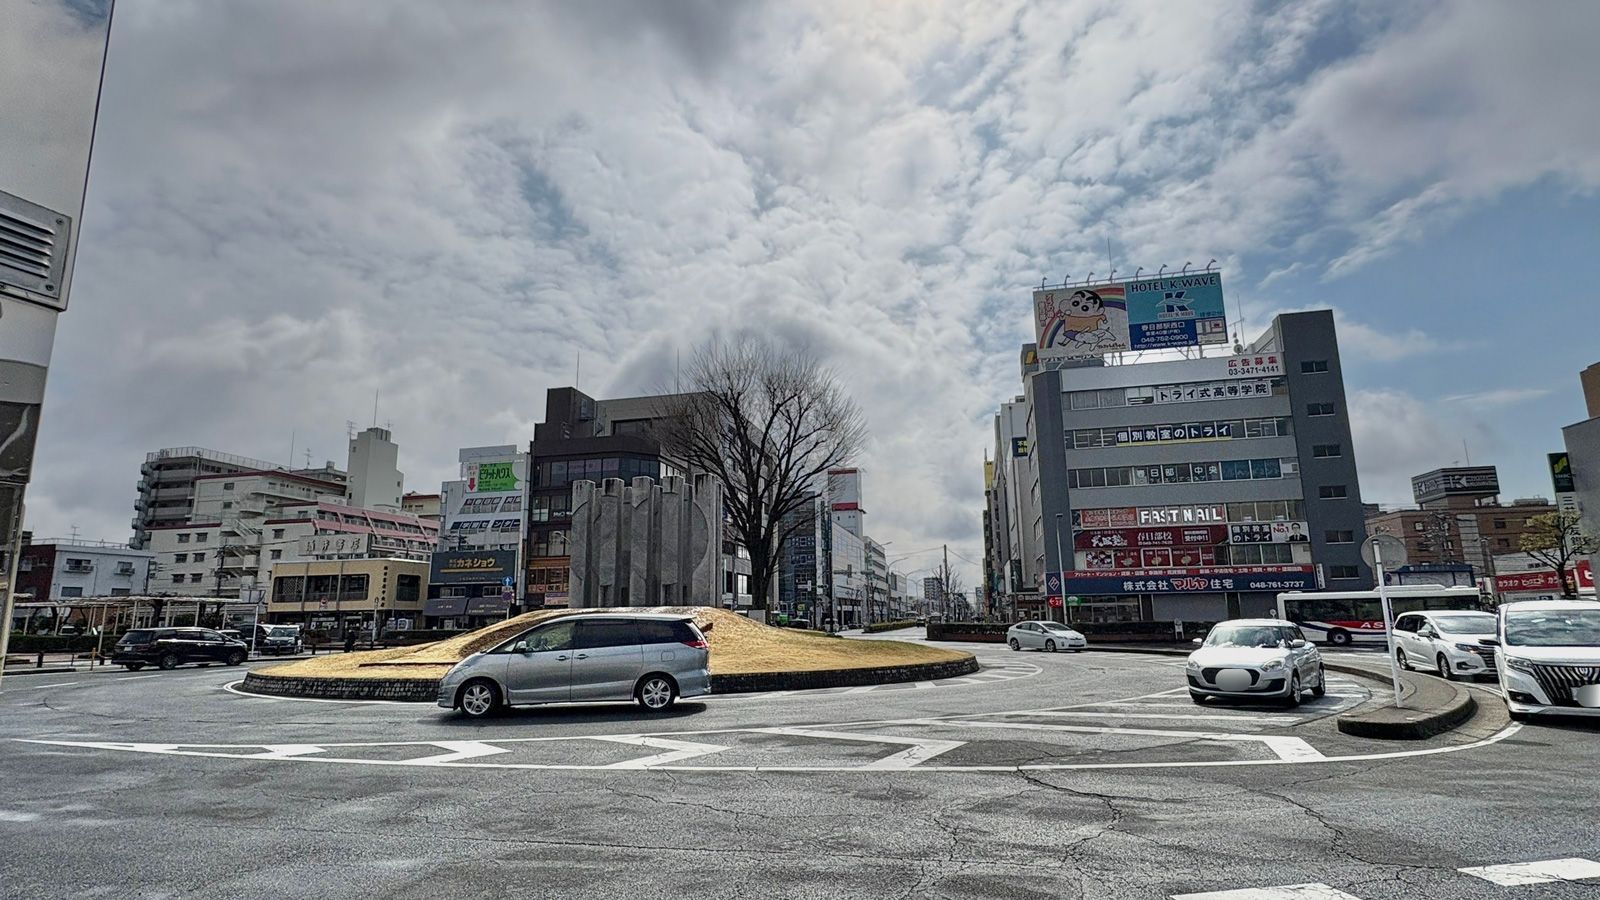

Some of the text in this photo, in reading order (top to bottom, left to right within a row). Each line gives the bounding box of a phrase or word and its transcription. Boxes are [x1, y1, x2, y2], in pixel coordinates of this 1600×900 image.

[1131, 281, 1166, 293] HOTEL
[1141, 321, 1185, 331] 春日部駅西口
[1228, 356, 1278, 368] 広告募集
[1228, 365, 1280, 376] 03-3471-4141
[1160, 382, 1268, 401] トライ式高等学院
[1117, 425, 1229, 443] 個別教室のトライ
[1140, 509, 1179, 524] FAST
[1183, 507, 1223, 522] NAIL
[1137, 532, 1173, 542] 春日部校
[457, 558, 496, 568] カネショウ
[1249, 580, 1305, 589] 048-761-3737
[1360, 621, 1384, 629] AS
